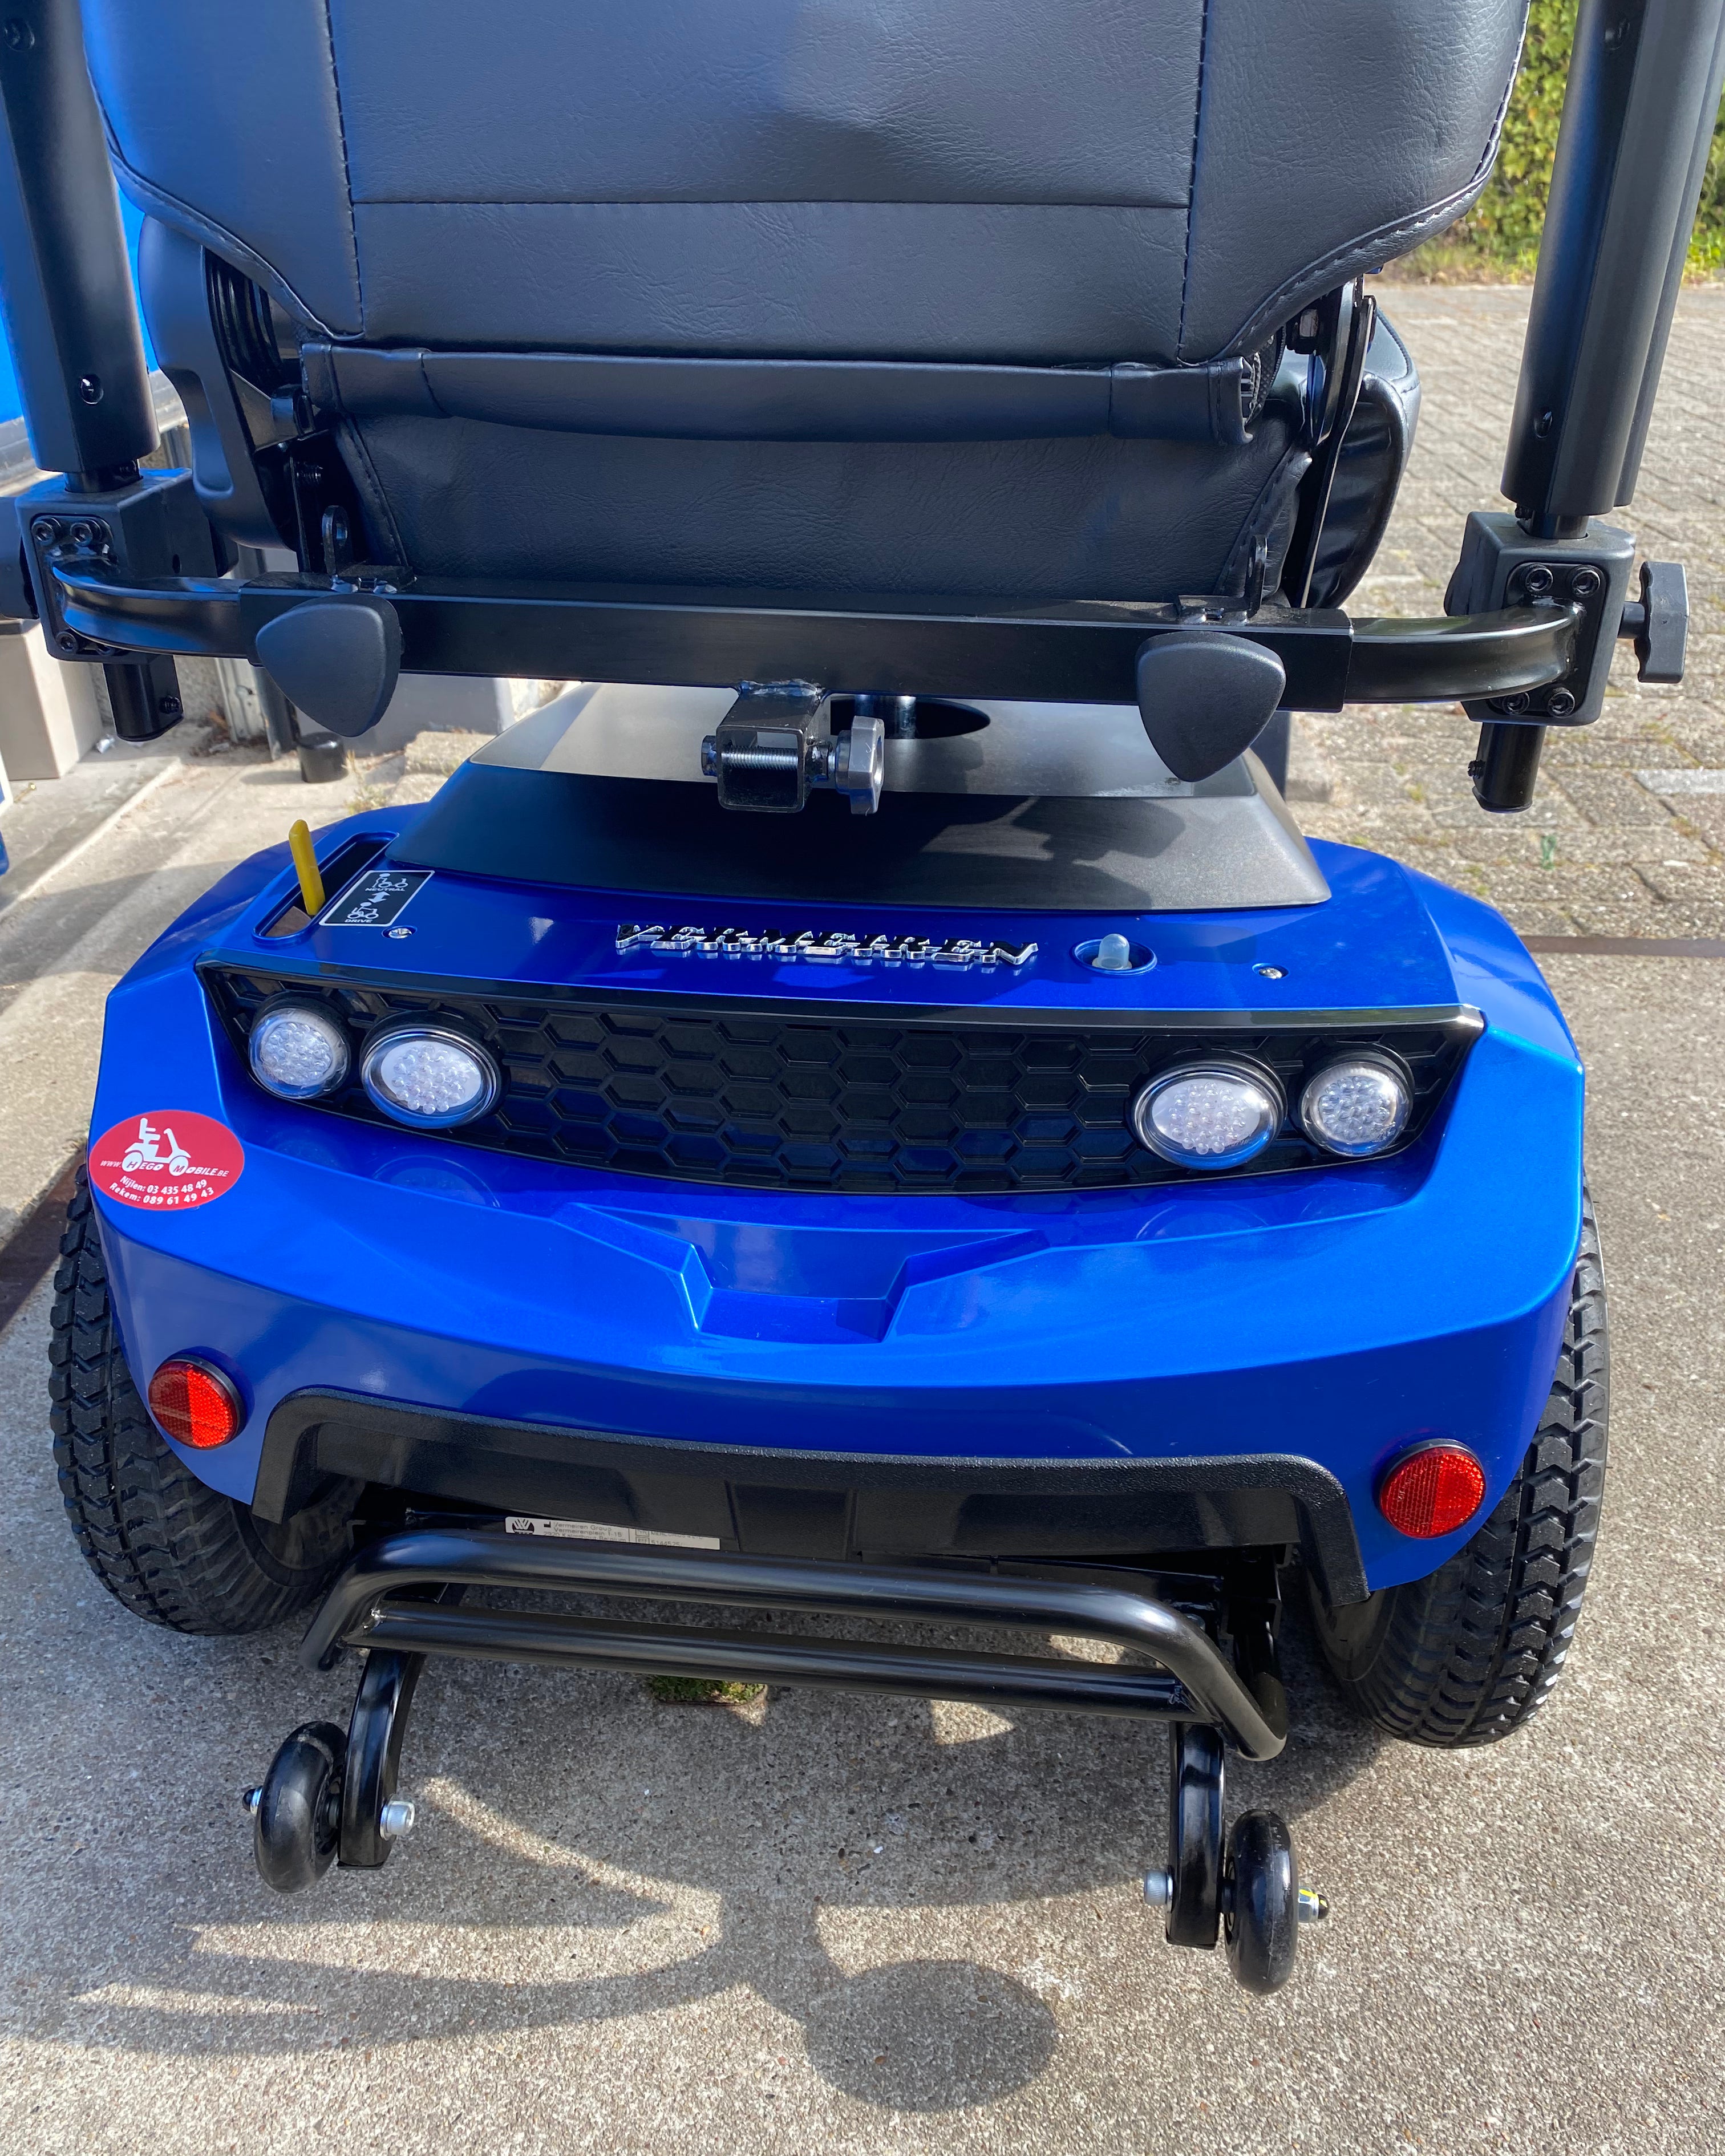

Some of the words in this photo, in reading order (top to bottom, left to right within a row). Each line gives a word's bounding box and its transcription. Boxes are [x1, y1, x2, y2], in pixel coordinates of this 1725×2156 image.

[616, 923, 1039, 965] VERMEIREN
[109, 1182, 141, 1202] Rekem:
[143, 1194, 164, 1205] 089
[167, 1195, 179, 1205] 61
[184, 1193, 197, 1203] 49
[201, 1187, 214, 1198] 43
[120, 1176, 146, 1192] Nijlen:
[147, 1185, 159, 1194] 03
[161, 1186, 179, 1195] 435
[181, 1184, 194, 1193] 48
[195, 1179, 208, 1190] 49
[553, 1527, 605, 1536] Vermeirenplein
